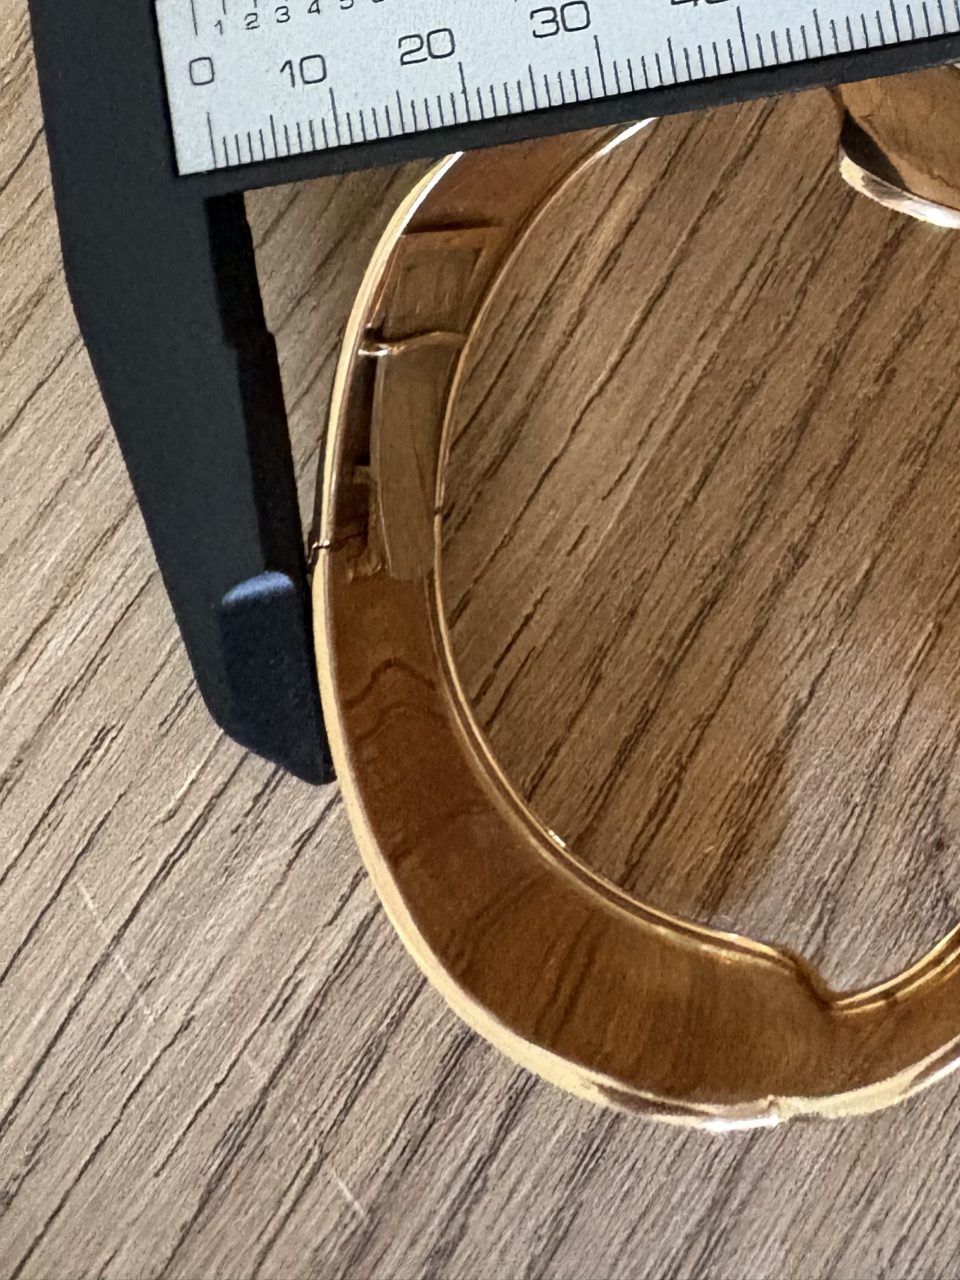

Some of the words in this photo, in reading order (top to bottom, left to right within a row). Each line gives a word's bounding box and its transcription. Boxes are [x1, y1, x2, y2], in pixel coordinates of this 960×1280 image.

[189, 56, 215, 86] 0
[279, 54, 327, 88] 10
[398, 28, 455, 65] 20
[529, 1, 591, 38] 30
[214, 19, 225, 35] 1
[244, 13, 261, 31] 2
[275, 6, 292, 23] 3
[307, 0, 322, 15] 4
